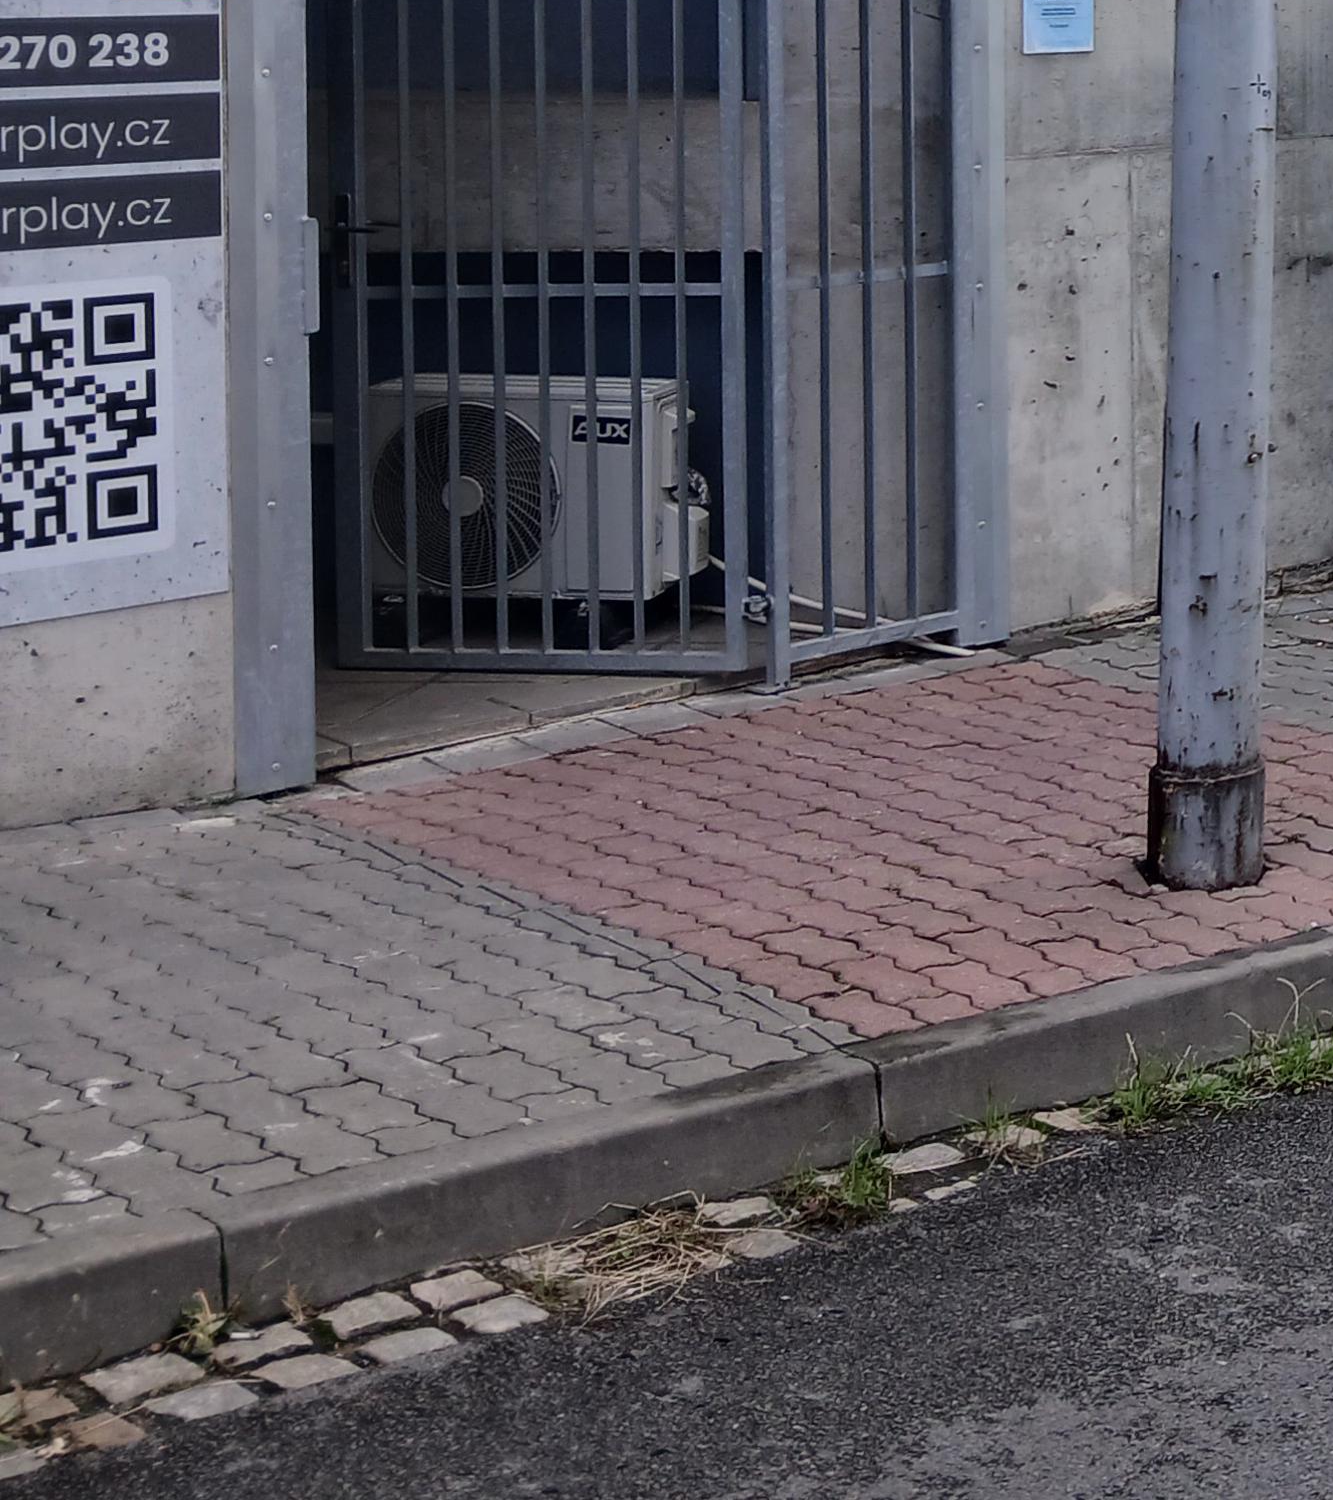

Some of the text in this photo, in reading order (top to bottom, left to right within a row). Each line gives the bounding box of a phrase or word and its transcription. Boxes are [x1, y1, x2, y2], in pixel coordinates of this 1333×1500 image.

[0, 32, 169, 70] 270 238
[2, 196, 173, 244] rplay.cz
